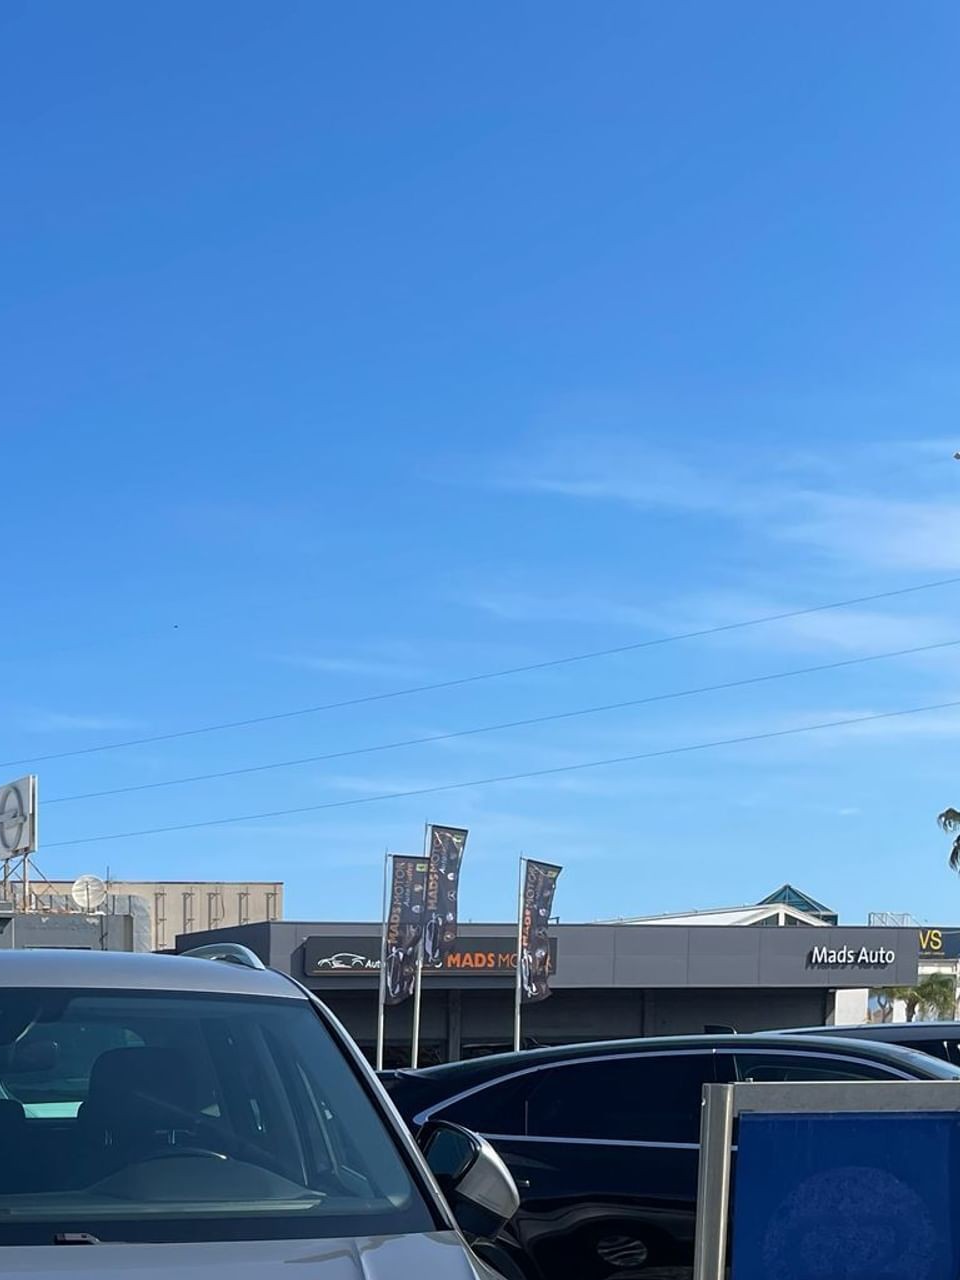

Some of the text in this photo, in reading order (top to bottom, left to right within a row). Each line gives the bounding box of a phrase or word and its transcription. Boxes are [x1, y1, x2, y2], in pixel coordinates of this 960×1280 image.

[387, 906, 402, 944] MADS
[447, 952, 495, 968] MADS
[811, 945, 895, 964] Mads Auto
